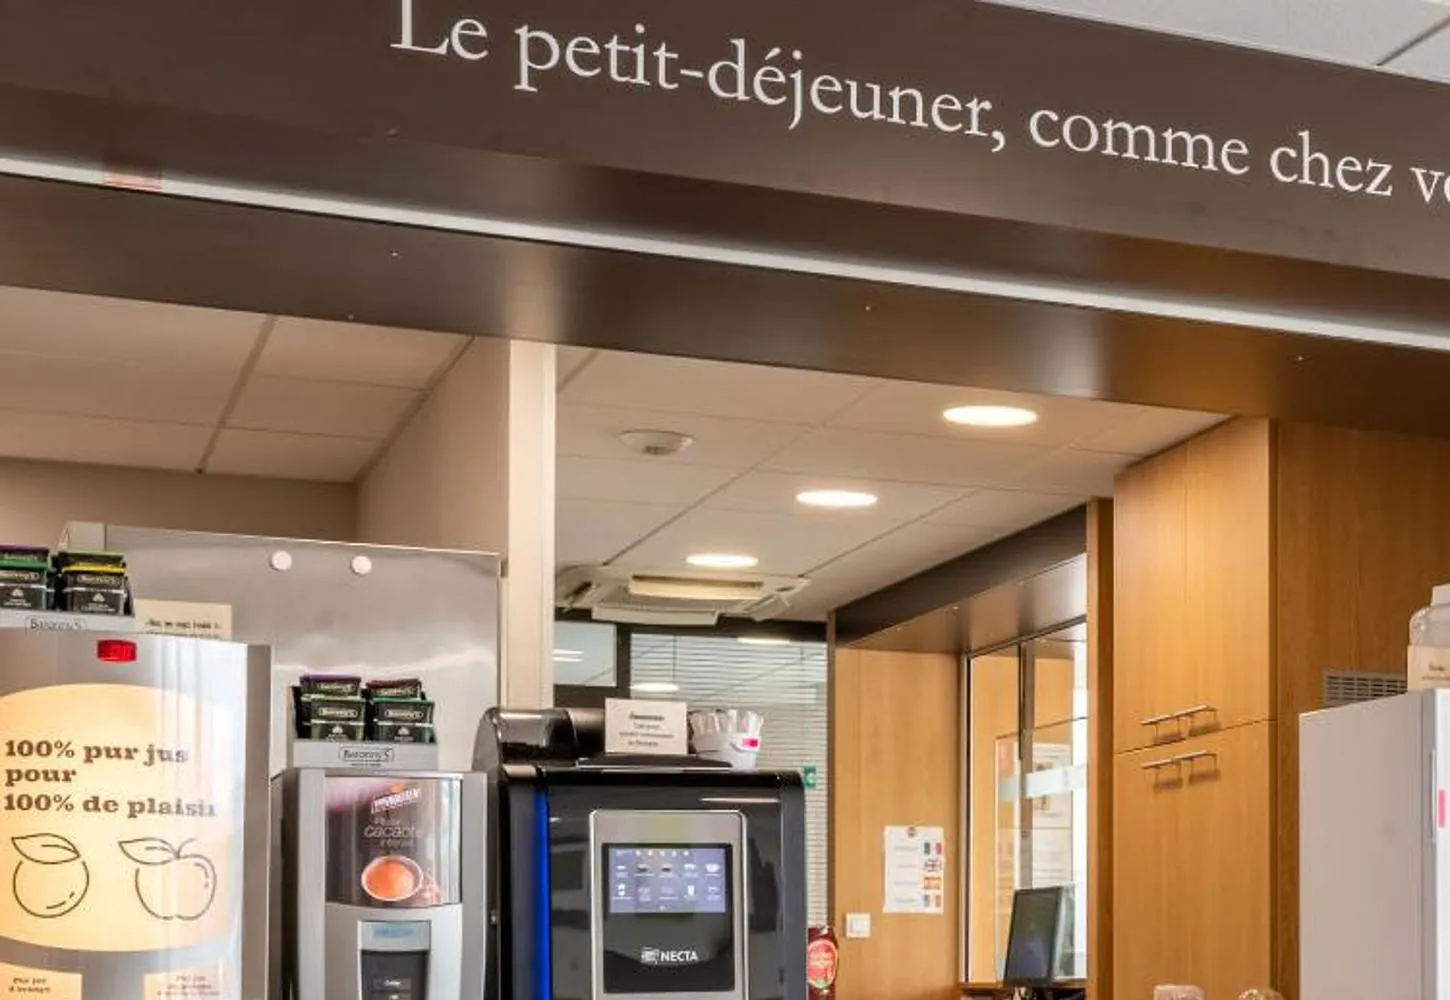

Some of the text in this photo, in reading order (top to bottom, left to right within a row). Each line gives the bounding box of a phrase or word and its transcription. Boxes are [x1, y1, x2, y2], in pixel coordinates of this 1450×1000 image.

[390, 0, 488, 60] Le
[514, 23, 1005, 153] petit-déjeuner,
[1029, 109, 1249, 176] comme
[1270, 130, 1393, 197] chez
[4, 740, 189, 766] 100% pur jus
[5, 768, 77, 787] pour
[4, 793, 217, 819] 100% de plaisir
[660, 950, 699, 962] NECTA
